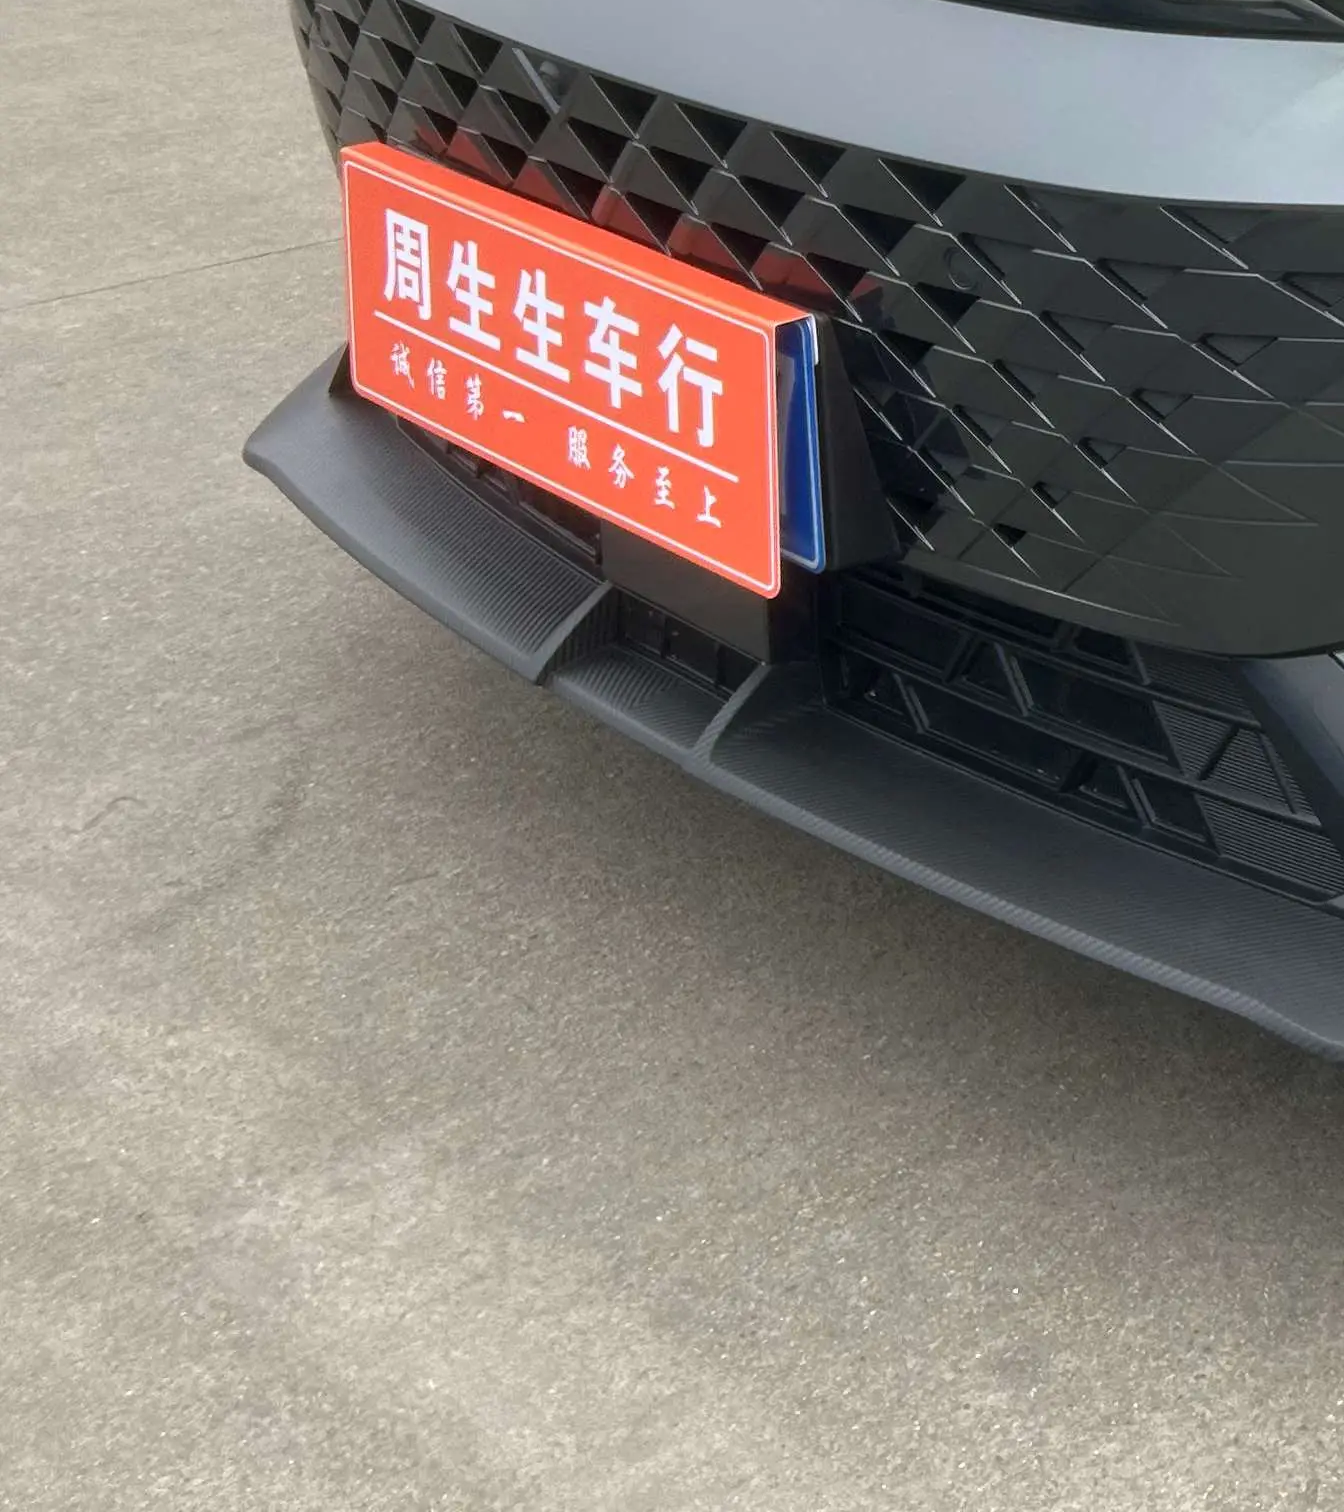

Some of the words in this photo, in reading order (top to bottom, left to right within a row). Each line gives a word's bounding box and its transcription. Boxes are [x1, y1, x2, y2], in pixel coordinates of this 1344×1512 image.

[383, 208, 723, 447] 周生生车行
[390, 343, 525, 423] 诚信第一
[567, 426, 723, 529] 服务至上
